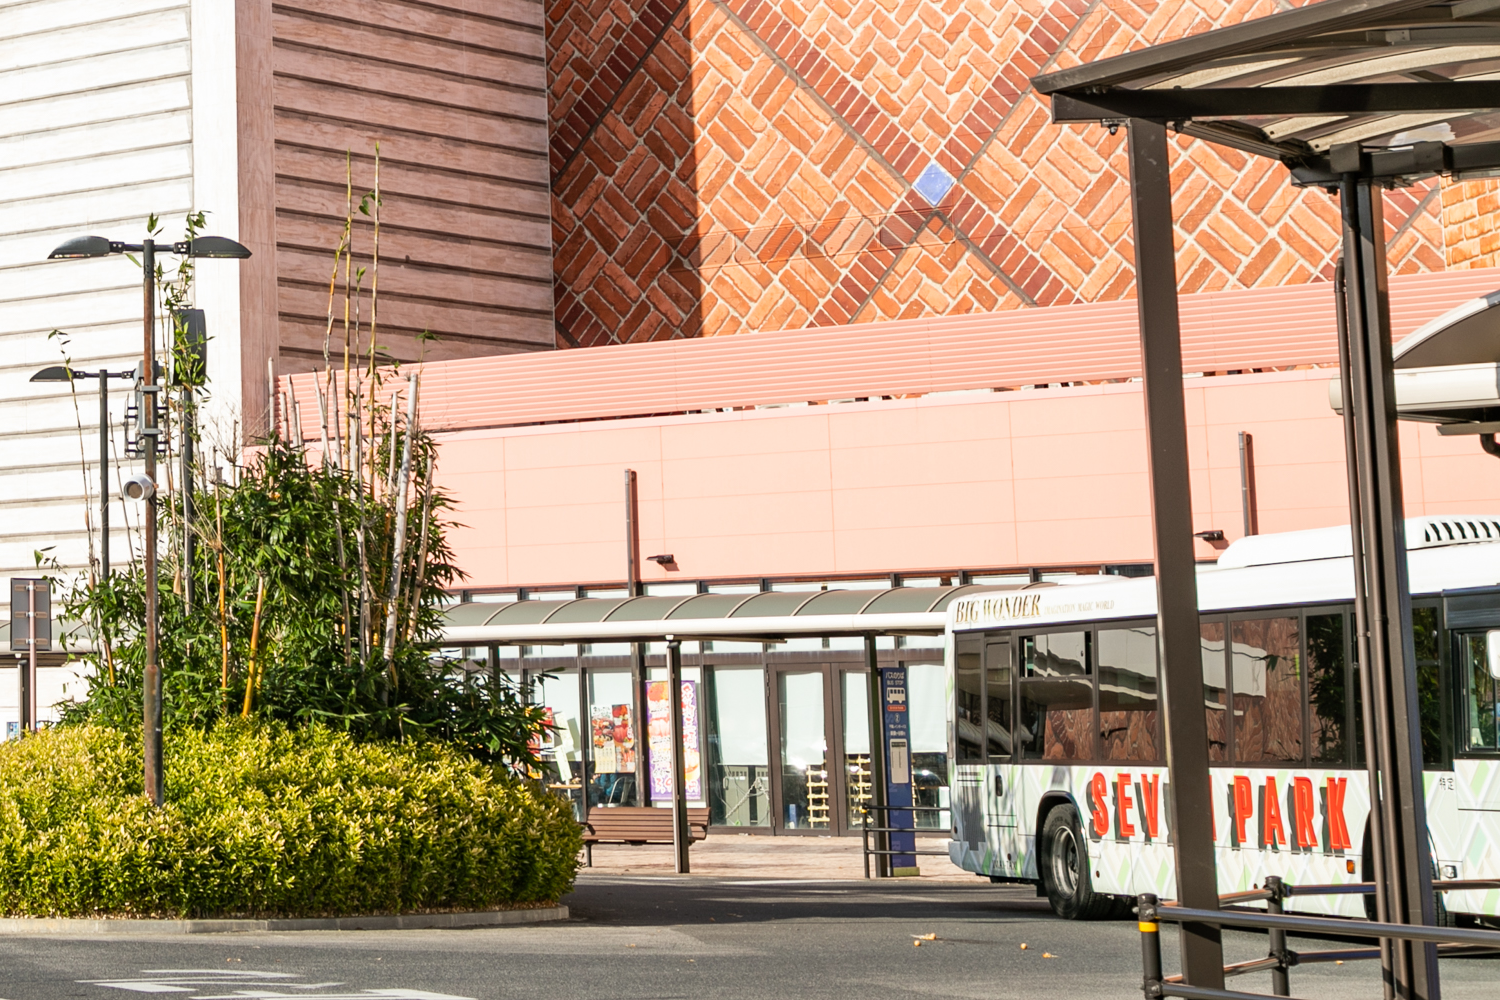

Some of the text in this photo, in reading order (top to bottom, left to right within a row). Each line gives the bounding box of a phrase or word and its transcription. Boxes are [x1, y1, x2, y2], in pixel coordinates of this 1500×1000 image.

[956, 601, 979, 624] BIG
[983, 594, 1041, 620] WONDER
[1095, 599, 1115, 611] WORLD
[1090, 771, 1352, 850] SEV PARK
